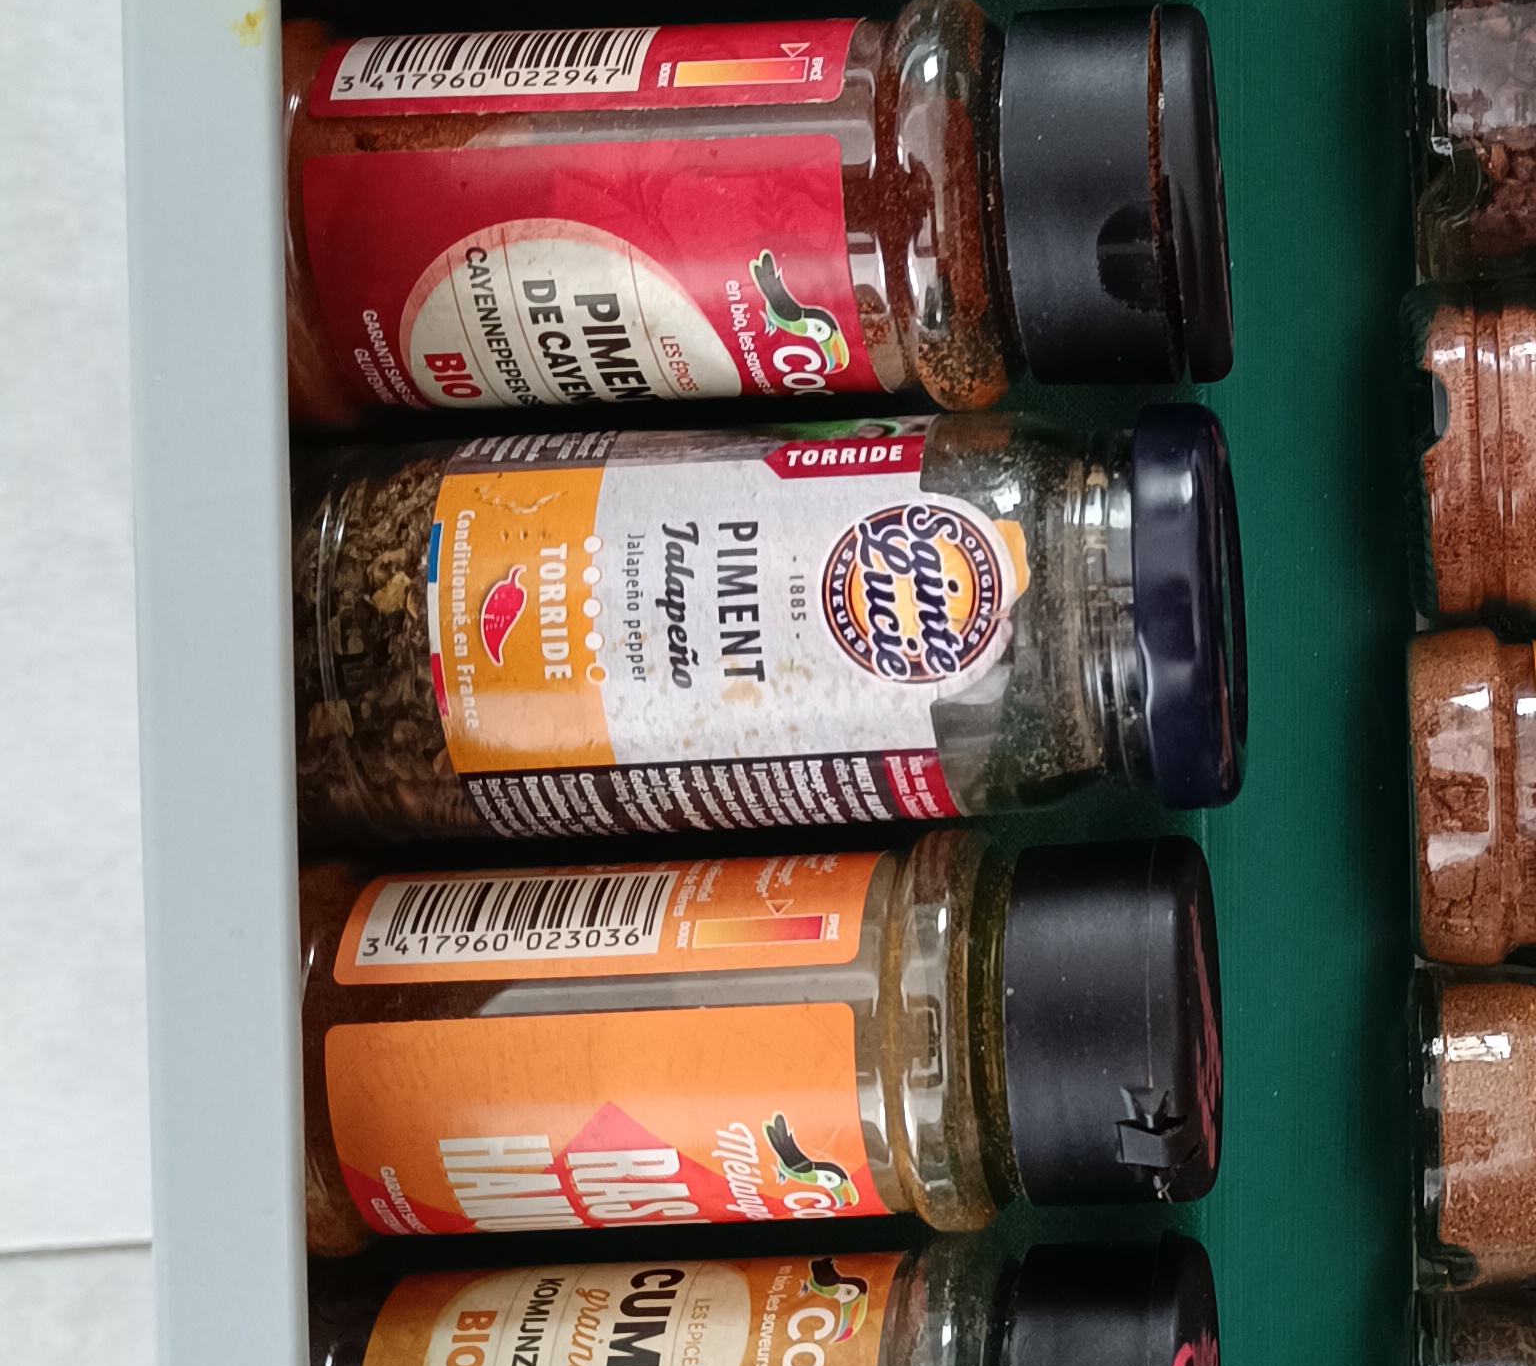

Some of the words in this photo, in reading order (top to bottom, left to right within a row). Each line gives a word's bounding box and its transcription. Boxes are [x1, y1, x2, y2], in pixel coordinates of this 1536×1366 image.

[522, 279, 563, 325] DE
[726, 280, 741, 301] en
[730, 304, 748, 331] bio,
[363, 310, 395, 367] GARANTI
[536, 331, 591, 403] CAYEN
[573, 292, 653, 401] PIMEN
[660, 336, 682, 358] LES
[738, 332, 755, 350] les
[423, 351, 482, 398] BIO
[787, 448, 904, 466] TORRIDE
[449, 510, 477, 627] Conditionné
[624, 533, 645, 613] Jalapeño
[716, 521, 765, 683] PIMENT
[831, 547, 870, 656] SAVEURS
[856, 523, 914, 682] Lucie
[905, 505, 962, 678] Sainte
[965, 534, 994, 645] ORIGINES
[538, 543, 572, 679] TORRIDE
[655, 521, 700, 690] Jalapeño
[452, 632, 472, 657] en
[619, 618, 649, 683] pepper
[454, 664, 482, 728] France
[437, 1135, 585, 1232] HANO
[566, 1148, 699, 1218] RAS
[712, 1122, 766, 1223] Mélange
[690, 1297, 713, 1321] LES
[761, 1296, 783, 1312] les
